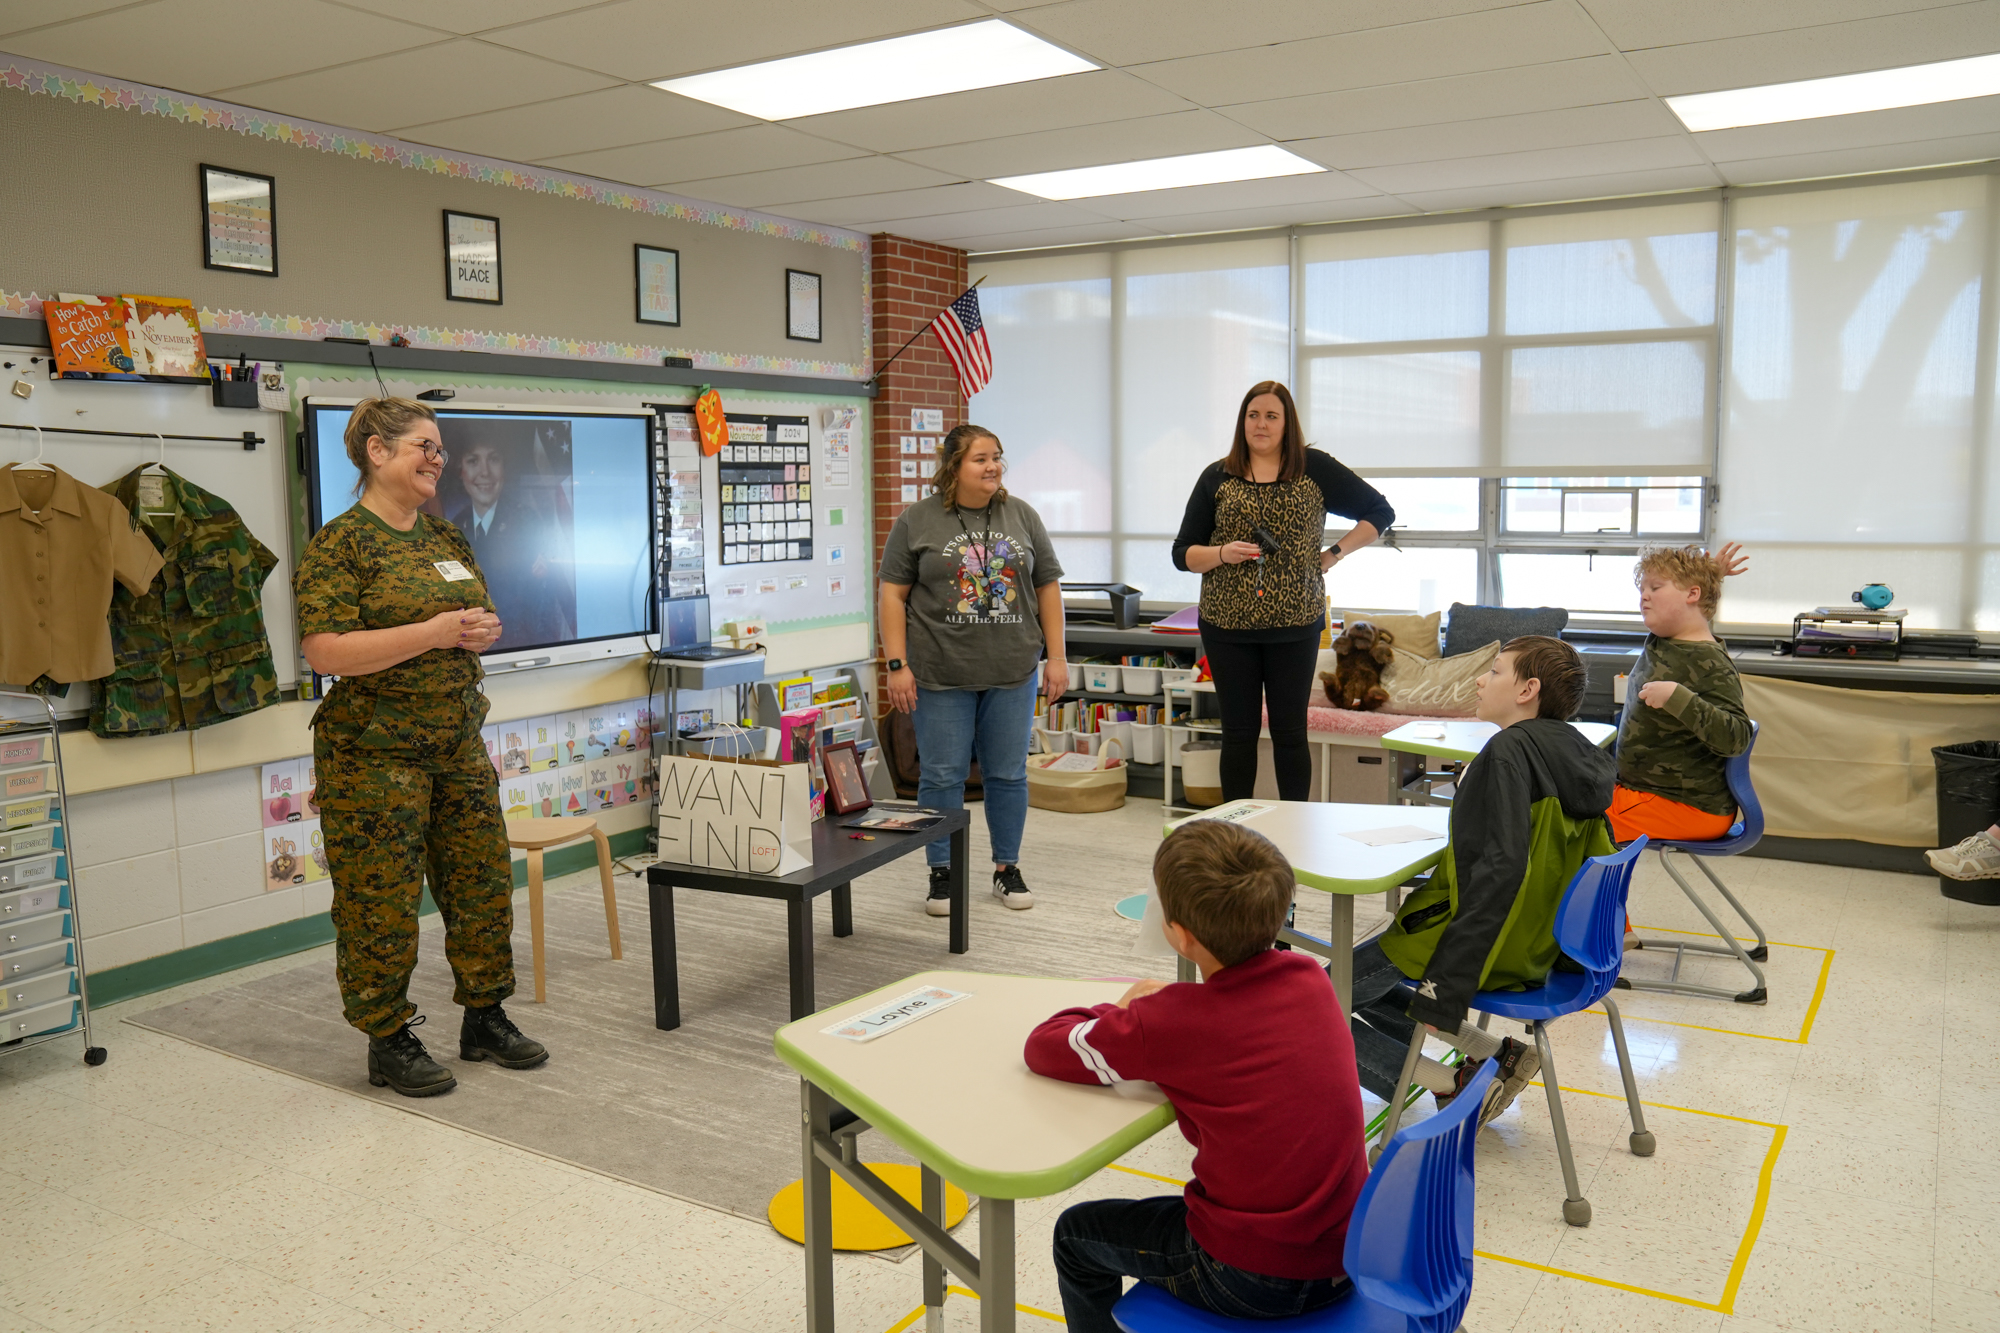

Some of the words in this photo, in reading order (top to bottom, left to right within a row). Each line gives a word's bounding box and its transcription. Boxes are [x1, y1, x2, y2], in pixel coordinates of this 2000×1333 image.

[458, 252, 489, 266] HAPPY
[459, 267, 490, 283] PLACE
[642, 293, 675, 312] START
[54, 306, 78, 323] How
[58, 326, 67, 334] to
[69, 310, 102, 336] Catch
[102, 310, 111, 320] a
[141, 330, 192, 345] NOVEMBER
[60, 331, 118, 364] Turkey
[730, 430, 763, 440] November
[784, 428, 801, 438] 2024
[802, 467, 806, 477] 2
[725, 488, 730, 498] 3
[740, 489, 744, 498] 4
[752, 488, 757, 497] 5
[777, 488, 780, 496] 7
[789, 486, 793, 496] 8
[803, 487, 806, 496] 9
[725, 508, 732, 518] 10
[739, 508, 744, 517] 11
[942, 540, 957, 557] IT'S
[955, 532, 984, 543] OKAY
[1005, 535, 1025, 558] FEEL
[945, 614, 965, 624] ALL
[967, 615, 991, 623] THE
[994, 614, 1023, 623] FEELS
[506, 732, 522, 749] Hh
[537, 728, 547, 744] Ii
[565, 721, 576, 739] Jj
[4, 748, 33, 758] MONDAY
[9, 776, 38, 788] TUESDAY
[270, 774, 292, 793] Aa
[509, 788, 525, 804] Uu
[537, 782, 553, 797] Vv
[562, 776, 583, 792] Ww
[591, 769, 607, 785] Xx
[617, 764, 631, 780] Yy
[659, 762, 785, 822] WANT
[7, 807, 45, 819] WEDNESDAY
[13, 838, 49, 850] THURSDAY
[272, 837, 296, 855] Nn
[752, 846, 777, 857] LOFT
[23, 866, 46, 878] FRIDAY
[32, 898, 42, 907] IEP
[860, 1000, 927, 1026] Layne
